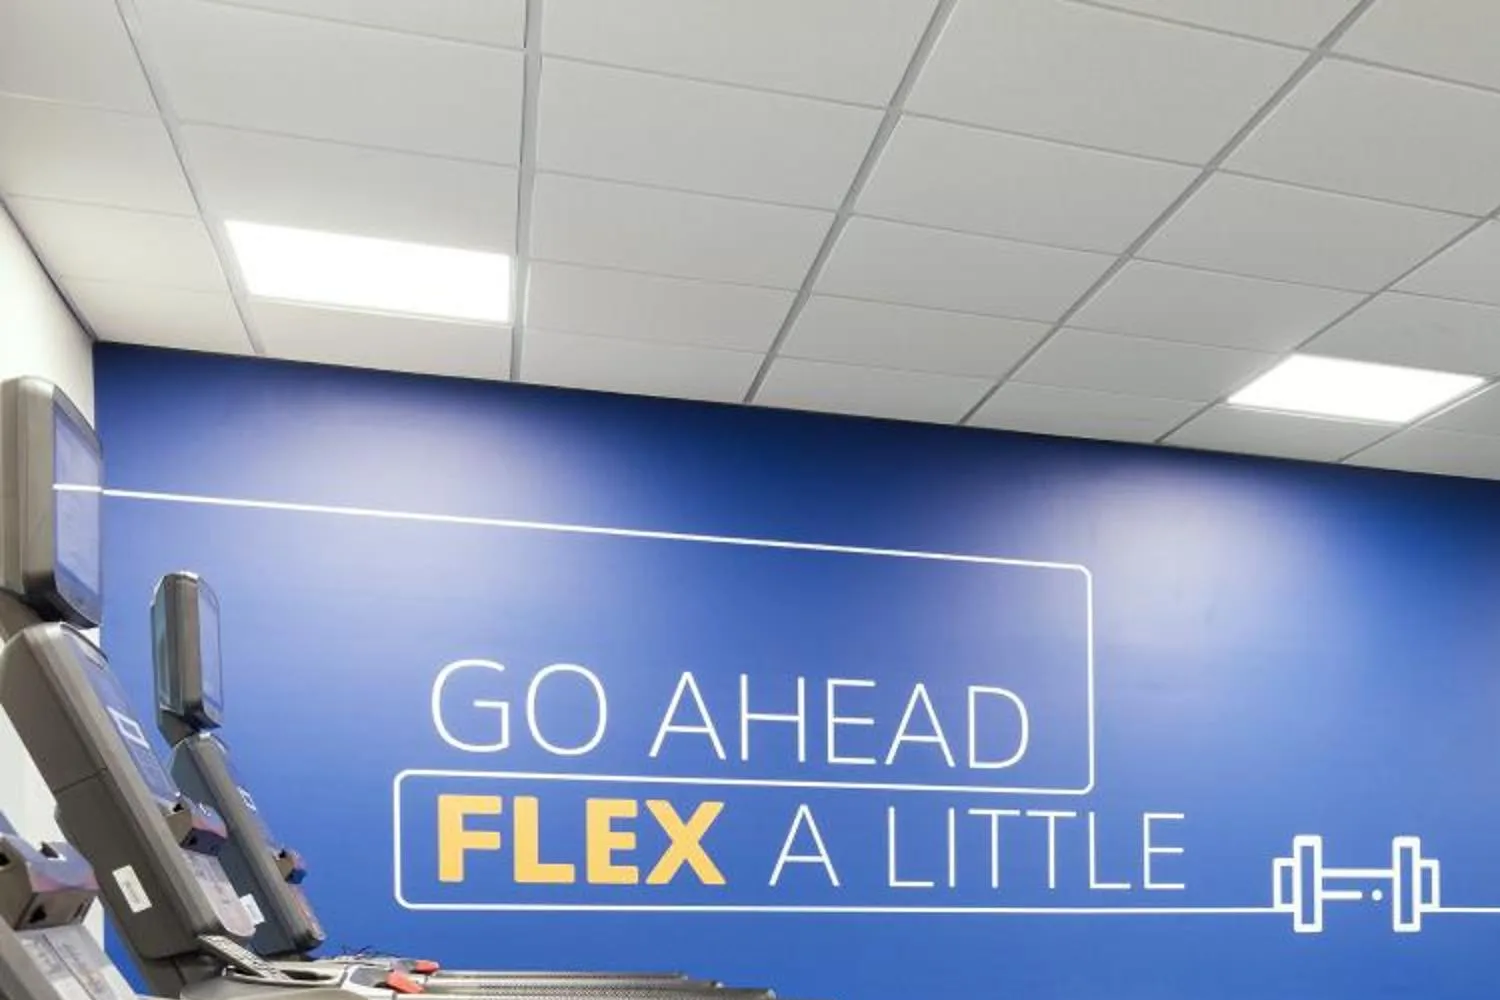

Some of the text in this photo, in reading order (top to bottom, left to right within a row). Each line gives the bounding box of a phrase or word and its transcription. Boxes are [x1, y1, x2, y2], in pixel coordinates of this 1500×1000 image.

[431, 659, 1029, 769] GO AHEAD
[437, 794, 1185, 890] FLEX A LITTLE
